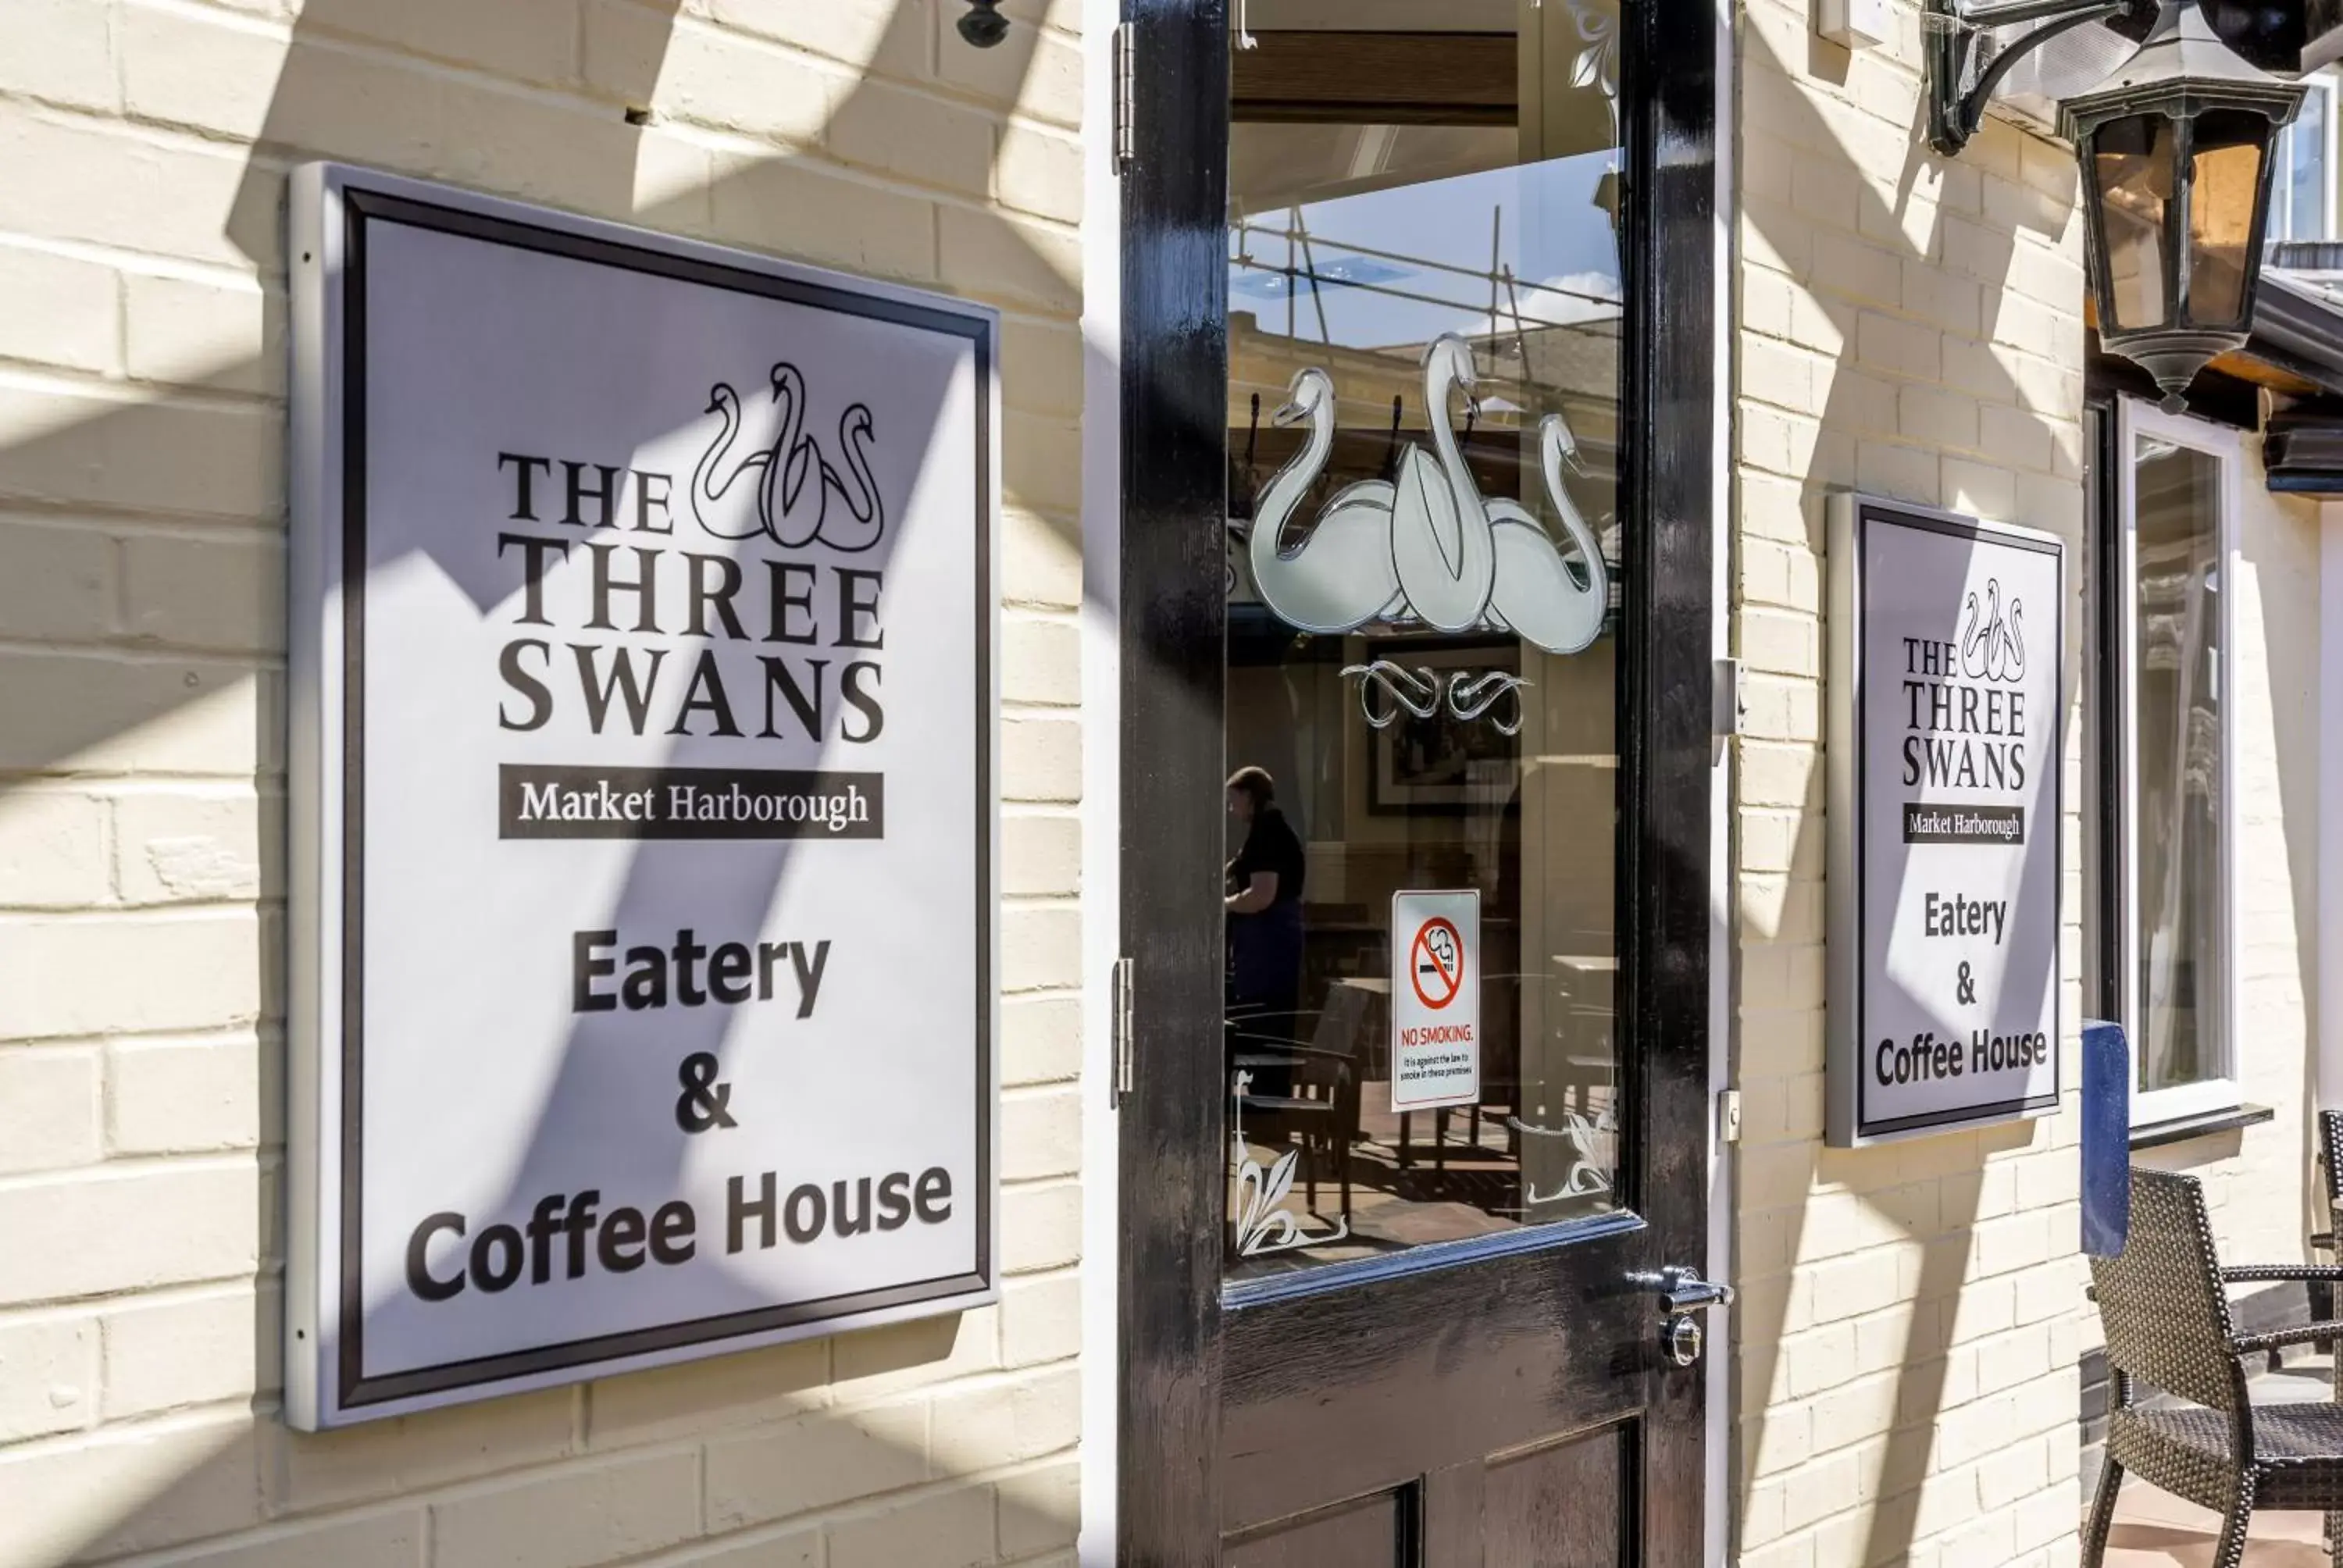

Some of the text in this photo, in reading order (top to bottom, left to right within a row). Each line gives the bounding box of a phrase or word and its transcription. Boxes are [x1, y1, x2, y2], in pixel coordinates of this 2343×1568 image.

[497, 451, 675, 536] THE
[497, 533, 884, 651] THREE
[1903, 636, 1957, 678] THE
[498, 637, 884, 745] SWANS
[1903, 679, 2025, 738] THREE
[1903, 735, 2025, 791] SWANS
[519, 781, 869, 832] Market Harborough
[1909, 811, 2020, 840] Market Harborough
[1924, 892, 2007, 945] Eatery
[572, 928, 831, 1019] Eatery
[1956, 960, 1977, 1005] &
[1402, 1025, 1474, 1046] NO SMOKING.
[1417, 1055, 1439, 1069] against
[1440, 1053, 1450, 1064] the
[1451, 1052, 1461, 1063] law
[1462, 1053, 1469, 1062] to
[1874, 1028, 2047, 1087] Coffee House
[675, 1051, 738, 1135] &
[1400, 1066, 1472, 1081] smoke in these premises
[406, 1167, 953, 1303] Coffee House
